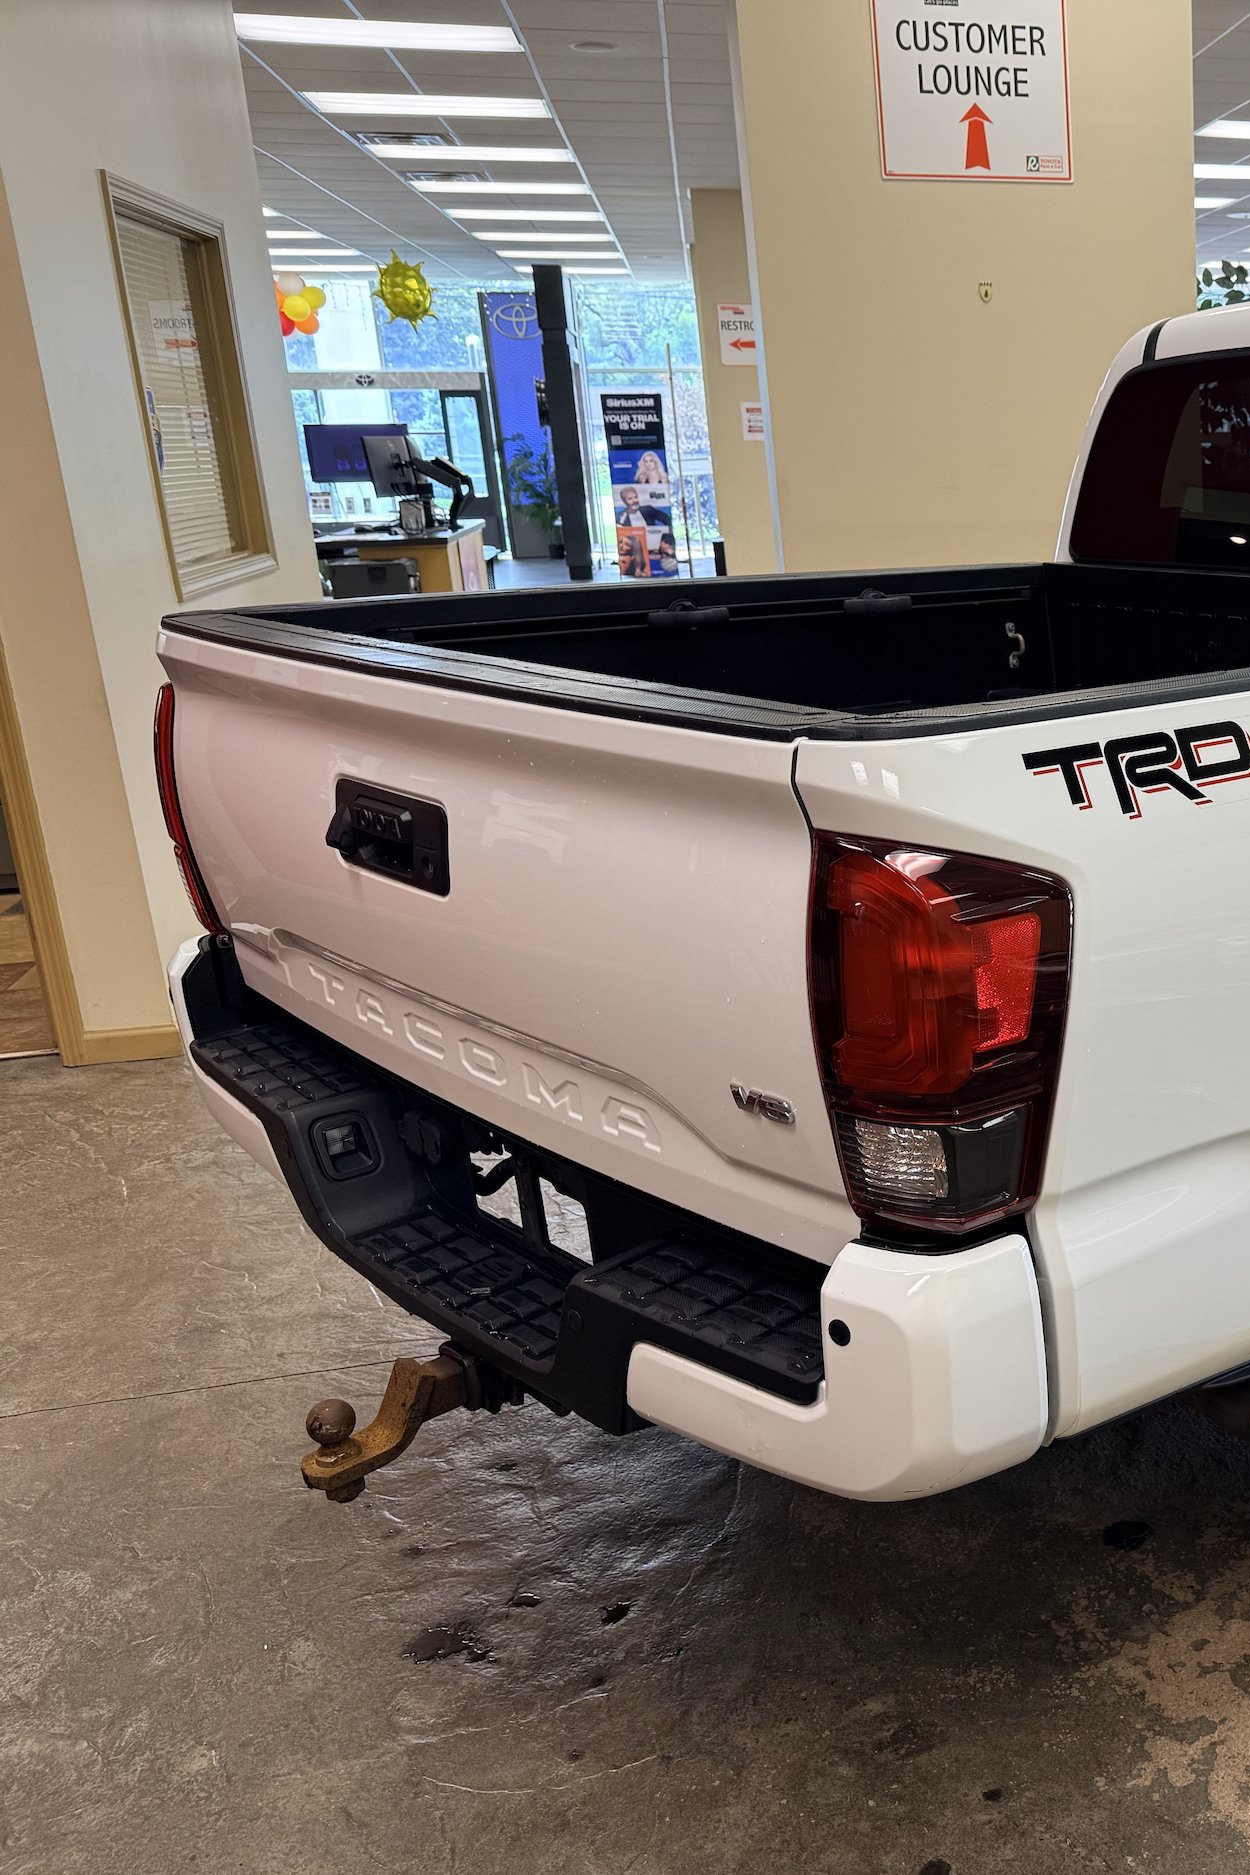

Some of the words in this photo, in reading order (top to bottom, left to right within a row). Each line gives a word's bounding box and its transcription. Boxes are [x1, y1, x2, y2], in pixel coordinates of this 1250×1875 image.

[895, 19, 1046, 56] CUSTOMER
[917, 63, 1029, 98] LOUNGE
[604, 414, 631, 423] YOUR
[631, 413, 660, 422] TRIAL
[606, 398, 655, 407] SiriusXM
[630, 421, 646, 430] ON
[308, 962, 661, 1153] TACOMA
[729, 1083, 796, 1125] V6
